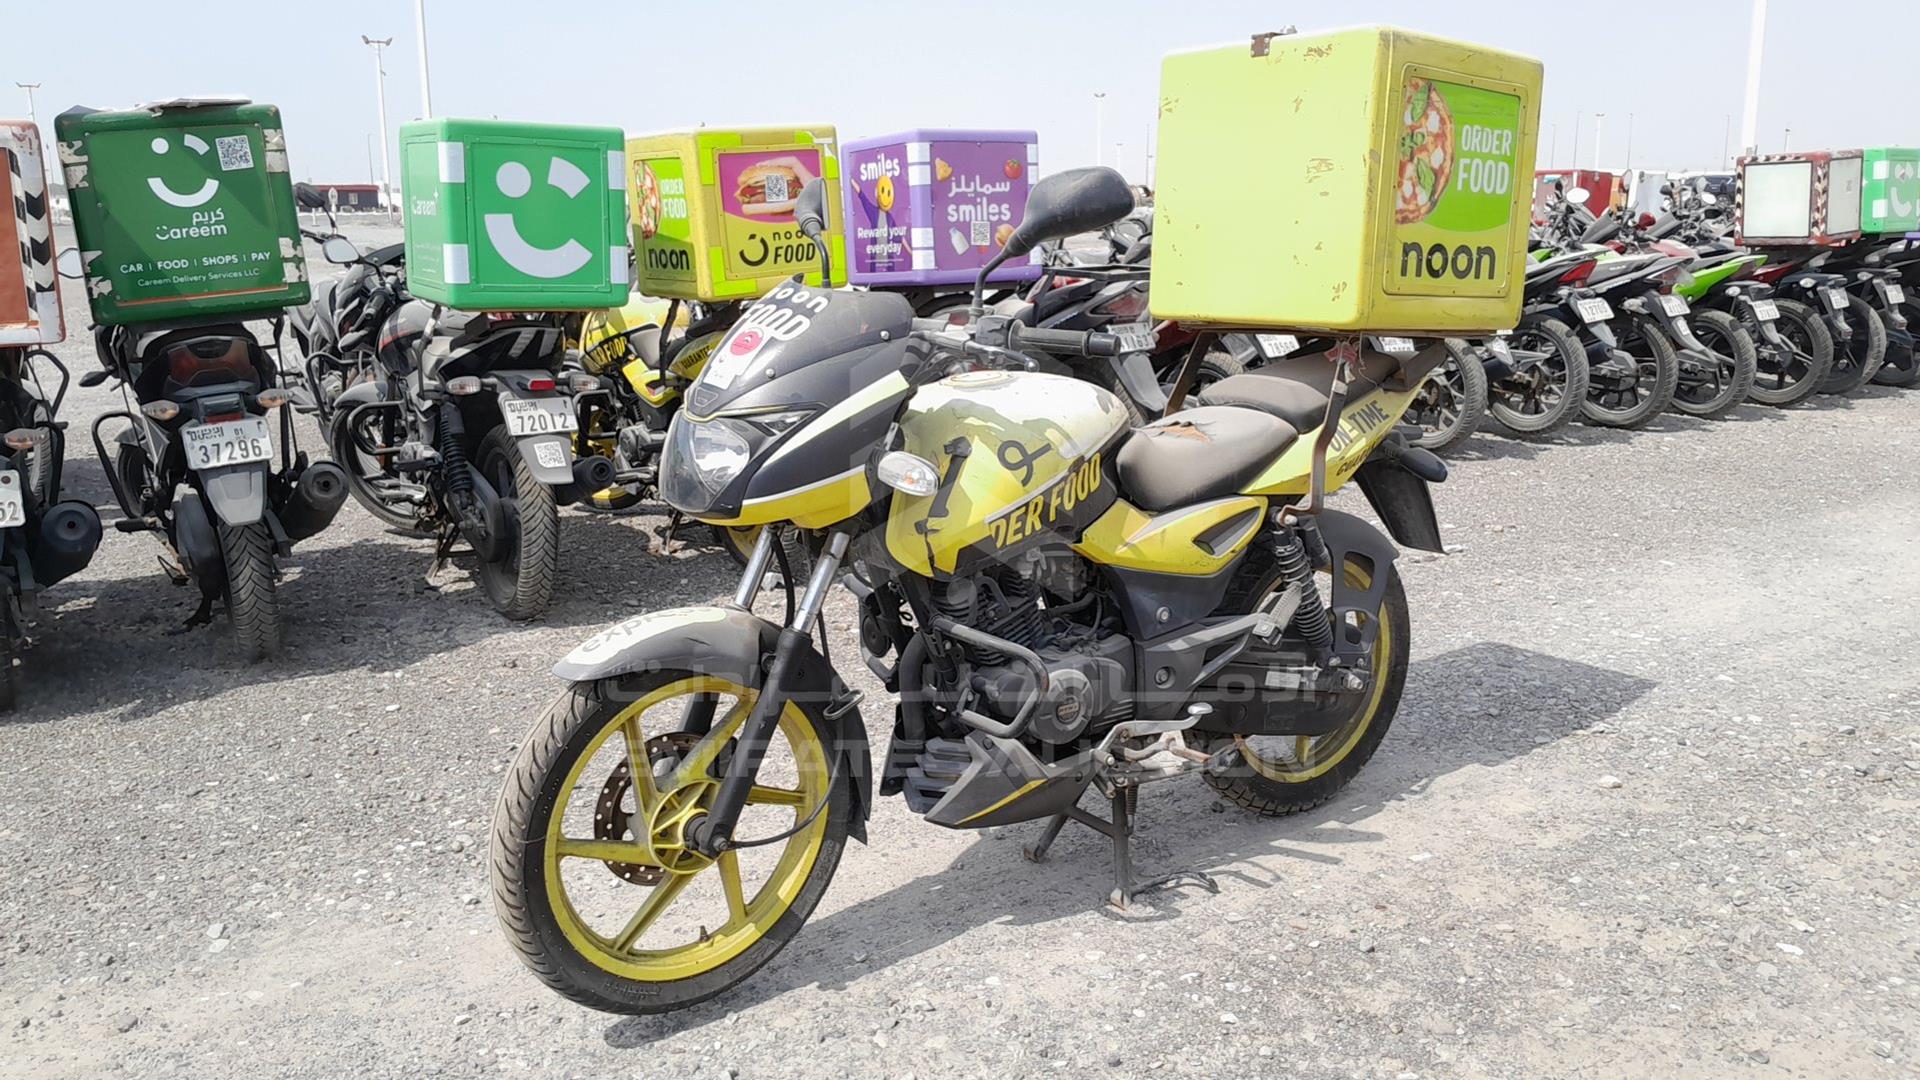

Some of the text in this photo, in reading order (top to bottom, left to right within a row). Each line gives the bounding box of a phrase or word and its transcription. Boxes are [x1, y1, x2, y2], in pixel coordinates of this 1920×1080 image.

[1461, 124, 1512, 156] ORDER
[860, 153, 900, 182] smiles
[1457, 158, 1510, 195] FOOD
[661, 178, 684, 195] ORDER
[948, 174, 1011, 197] سمايلز
[192, 207, 225, 226] كريم
[663, 198, 688, 218] FOOD
[947, 197, 1011, 222] smiles
[155, 224, 228, 241] Careem
[772, 229, 804, 241] noo
[857, 226, 907, 240] Reward your
[648, 248, 690, 271] noon
[773, 242, 816, 265] FOOD
[866, 241, 902, 255] everyday
[120, 251, 271, 274] CAR FOOD SHOPS PAY
[1400, 241, 1496, 280] noon
[137, 268, 260, 287] Careem Delivery Services LLC
[516, 412, 570, 433] 72012
[198, 438, 262, 464] 37296
[1049, 452, 1102, 522] FOOD
